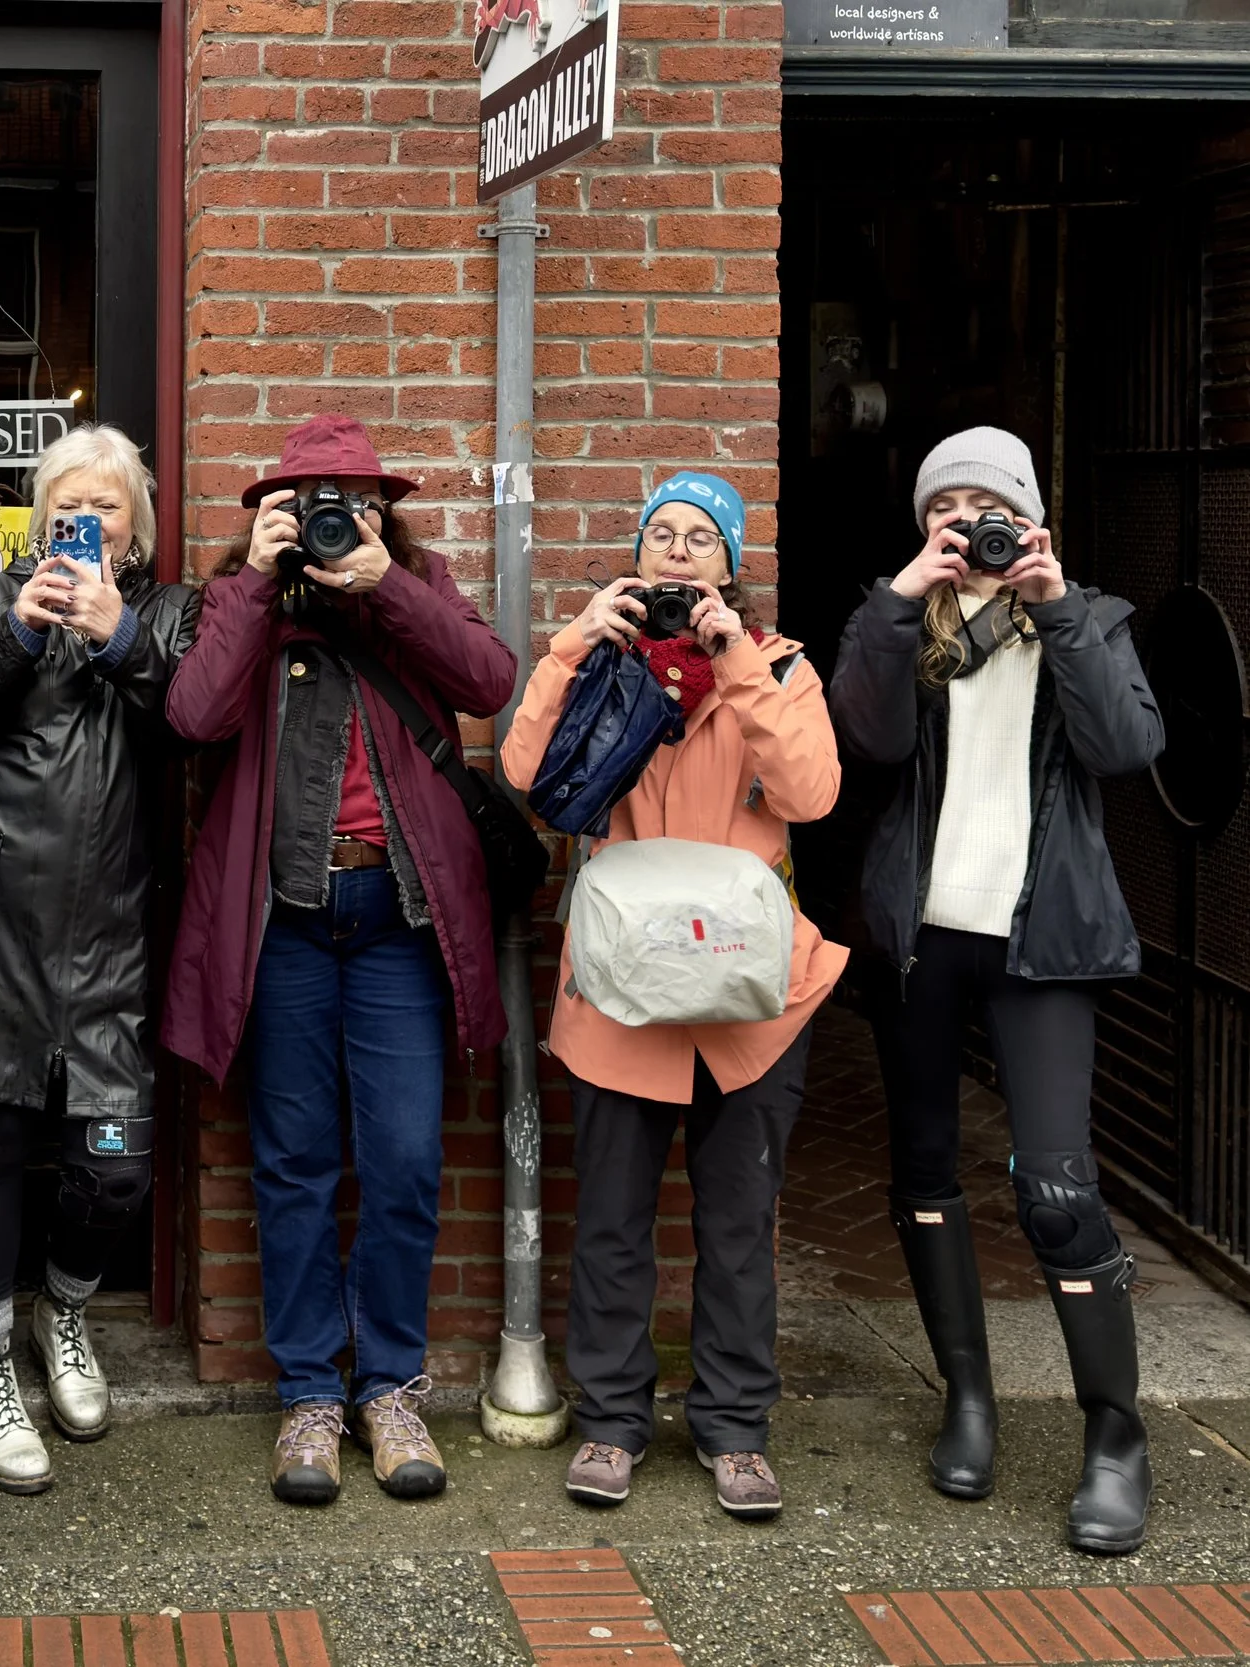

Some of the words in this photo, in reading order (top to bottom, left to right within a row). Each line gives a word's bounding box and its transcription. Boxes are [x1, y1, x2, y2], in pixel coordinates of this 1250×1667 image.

[834, 4, 863, 18] local
[867, 6, 924, 22] designers
[928, 6, 939, 19] &
[830, 26, 892, 41] worldwide
[896, 28, 944, 41] artisans
[485, 80, 551, 184] DRAGON
[551, 43, 605, 148] ALLEY
[713, 943, 746, 954] ELITE
